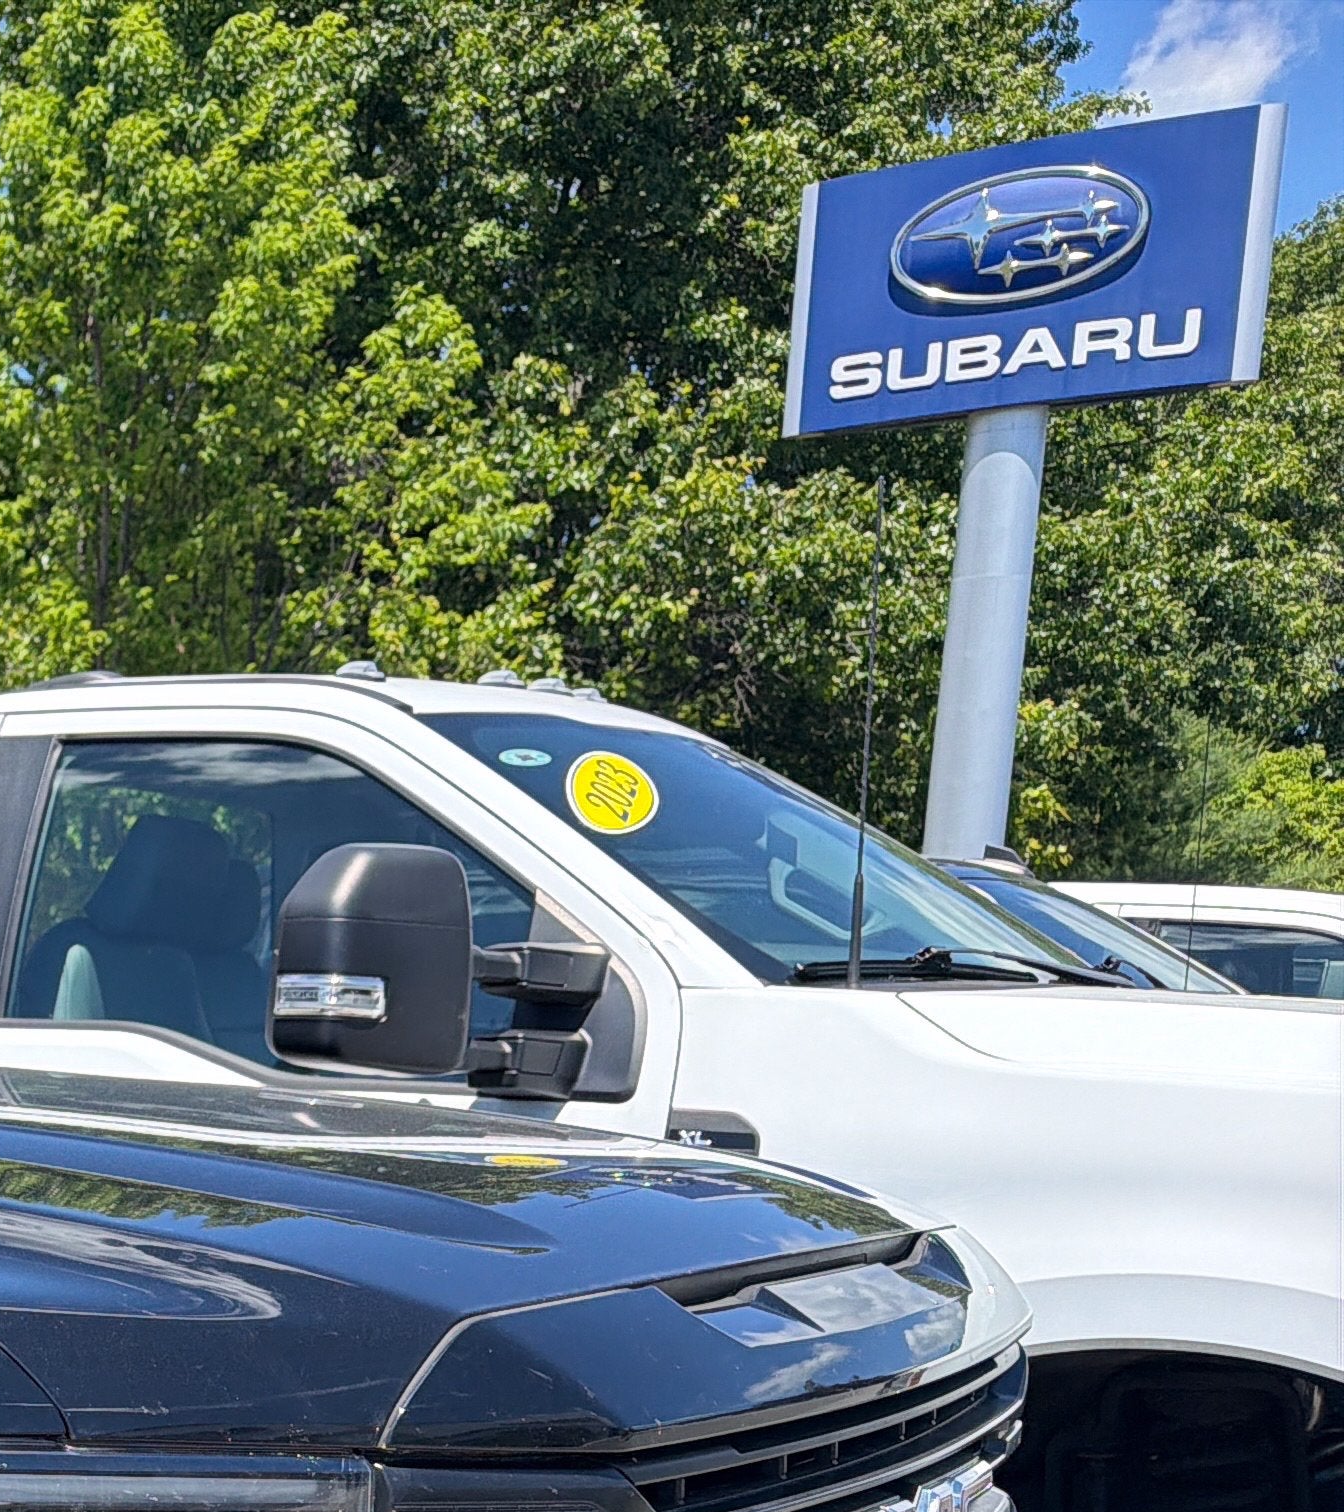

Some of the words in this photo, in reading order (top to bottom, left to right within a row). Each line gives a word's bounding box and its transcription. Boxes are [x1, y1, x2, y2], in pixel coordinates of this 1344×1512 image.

[828, 307, 1202, 401] SUBARU
[585, 759, 639, 823] 2023
[678, 1129, 712, 1146] XL
